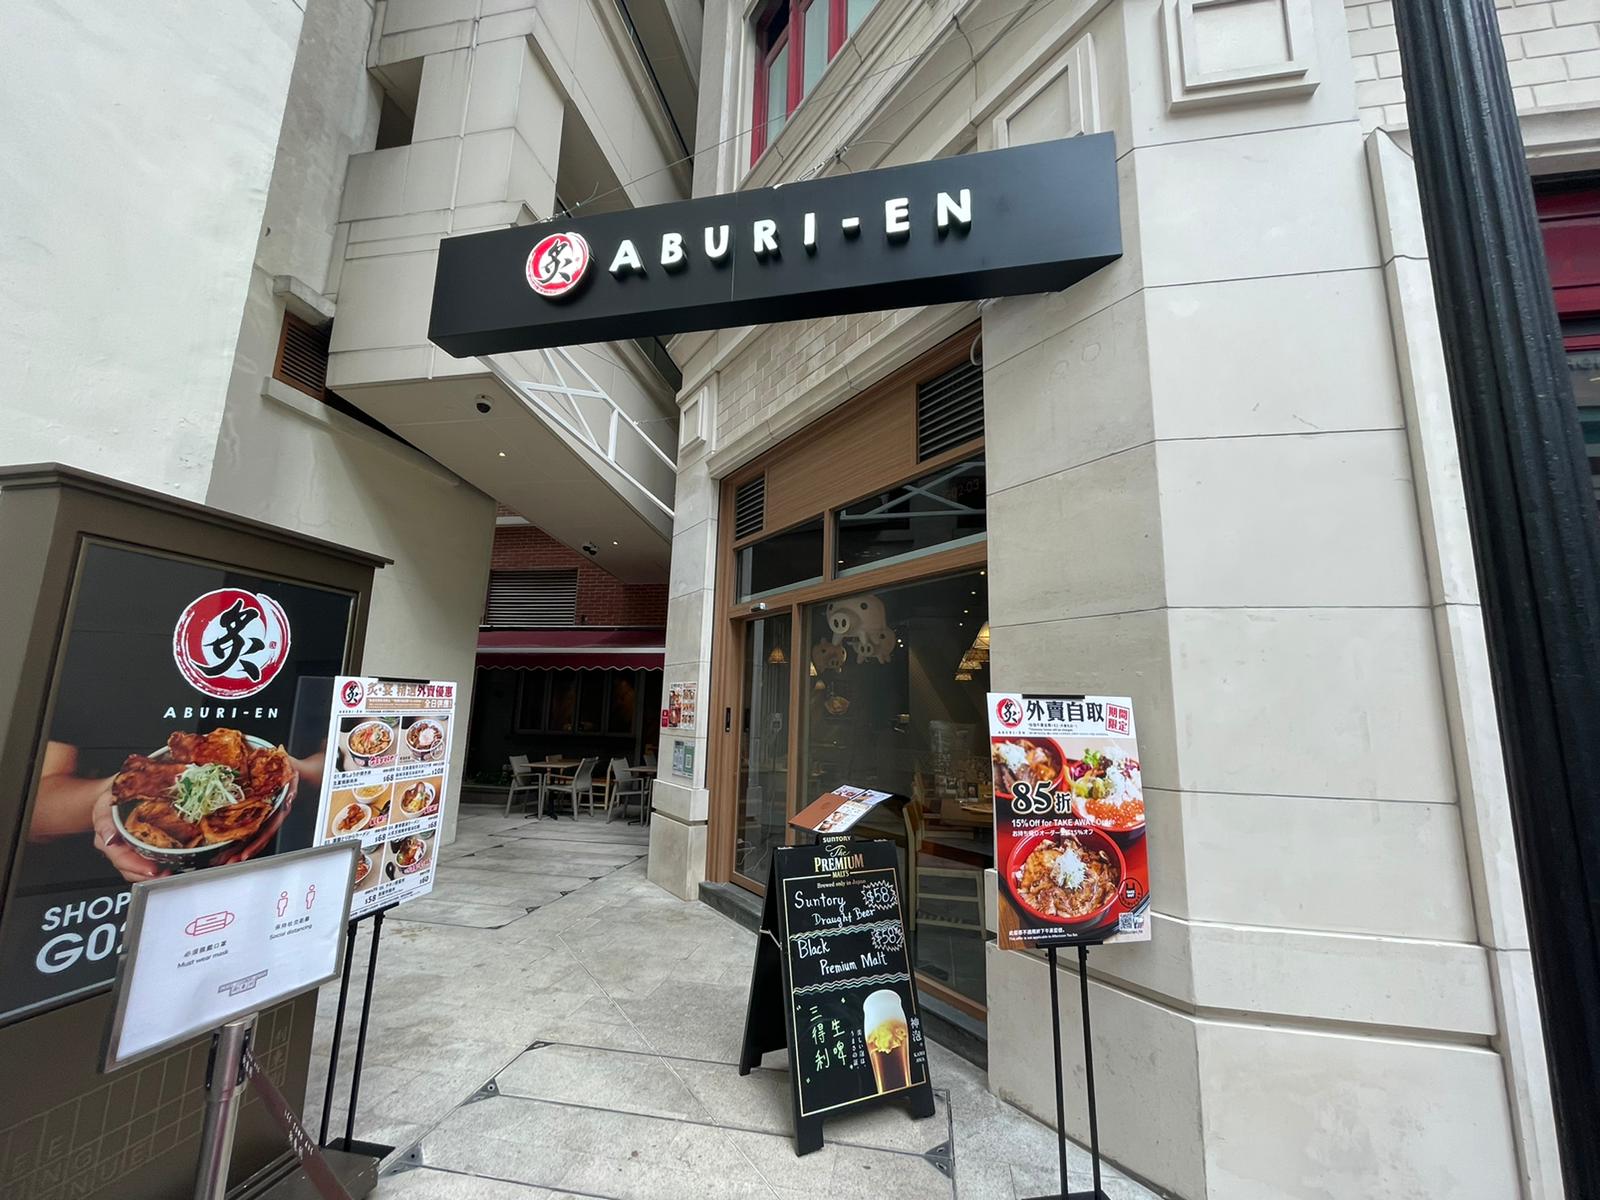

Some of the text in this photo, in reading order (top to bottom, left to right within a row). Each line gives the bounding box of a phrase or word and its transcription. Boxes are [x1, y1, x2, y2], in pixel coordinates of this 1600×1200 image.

[609, 188, 973, 276] ABURI-EN
[163, 706, 279, 720] ABURI-EN
[1026, 700, 1105, 722] 外賣自取
[1011, 818, 1029, 828] 15%
[1030, 818, 1040, 827] Off
[1041, 818, 1053, 827] for
[1053, 818, 1073, 827] TAKE
[1074, 818, 1095, 826] AWAY
[825, 844, 850, 857] The
[814, 853, 865, 873] PREMIUM
[794, 890, 846, 912] Suntory
[866, 886, 890, 904] $58
[41, 891, 132, 931] SHOP
[812, 907, 876, 928] Draught Beer
[36, 921, 127, 974] G0
[797, 938, 830, 959] Black
[819, 952, 888, 976] Premium Malt
